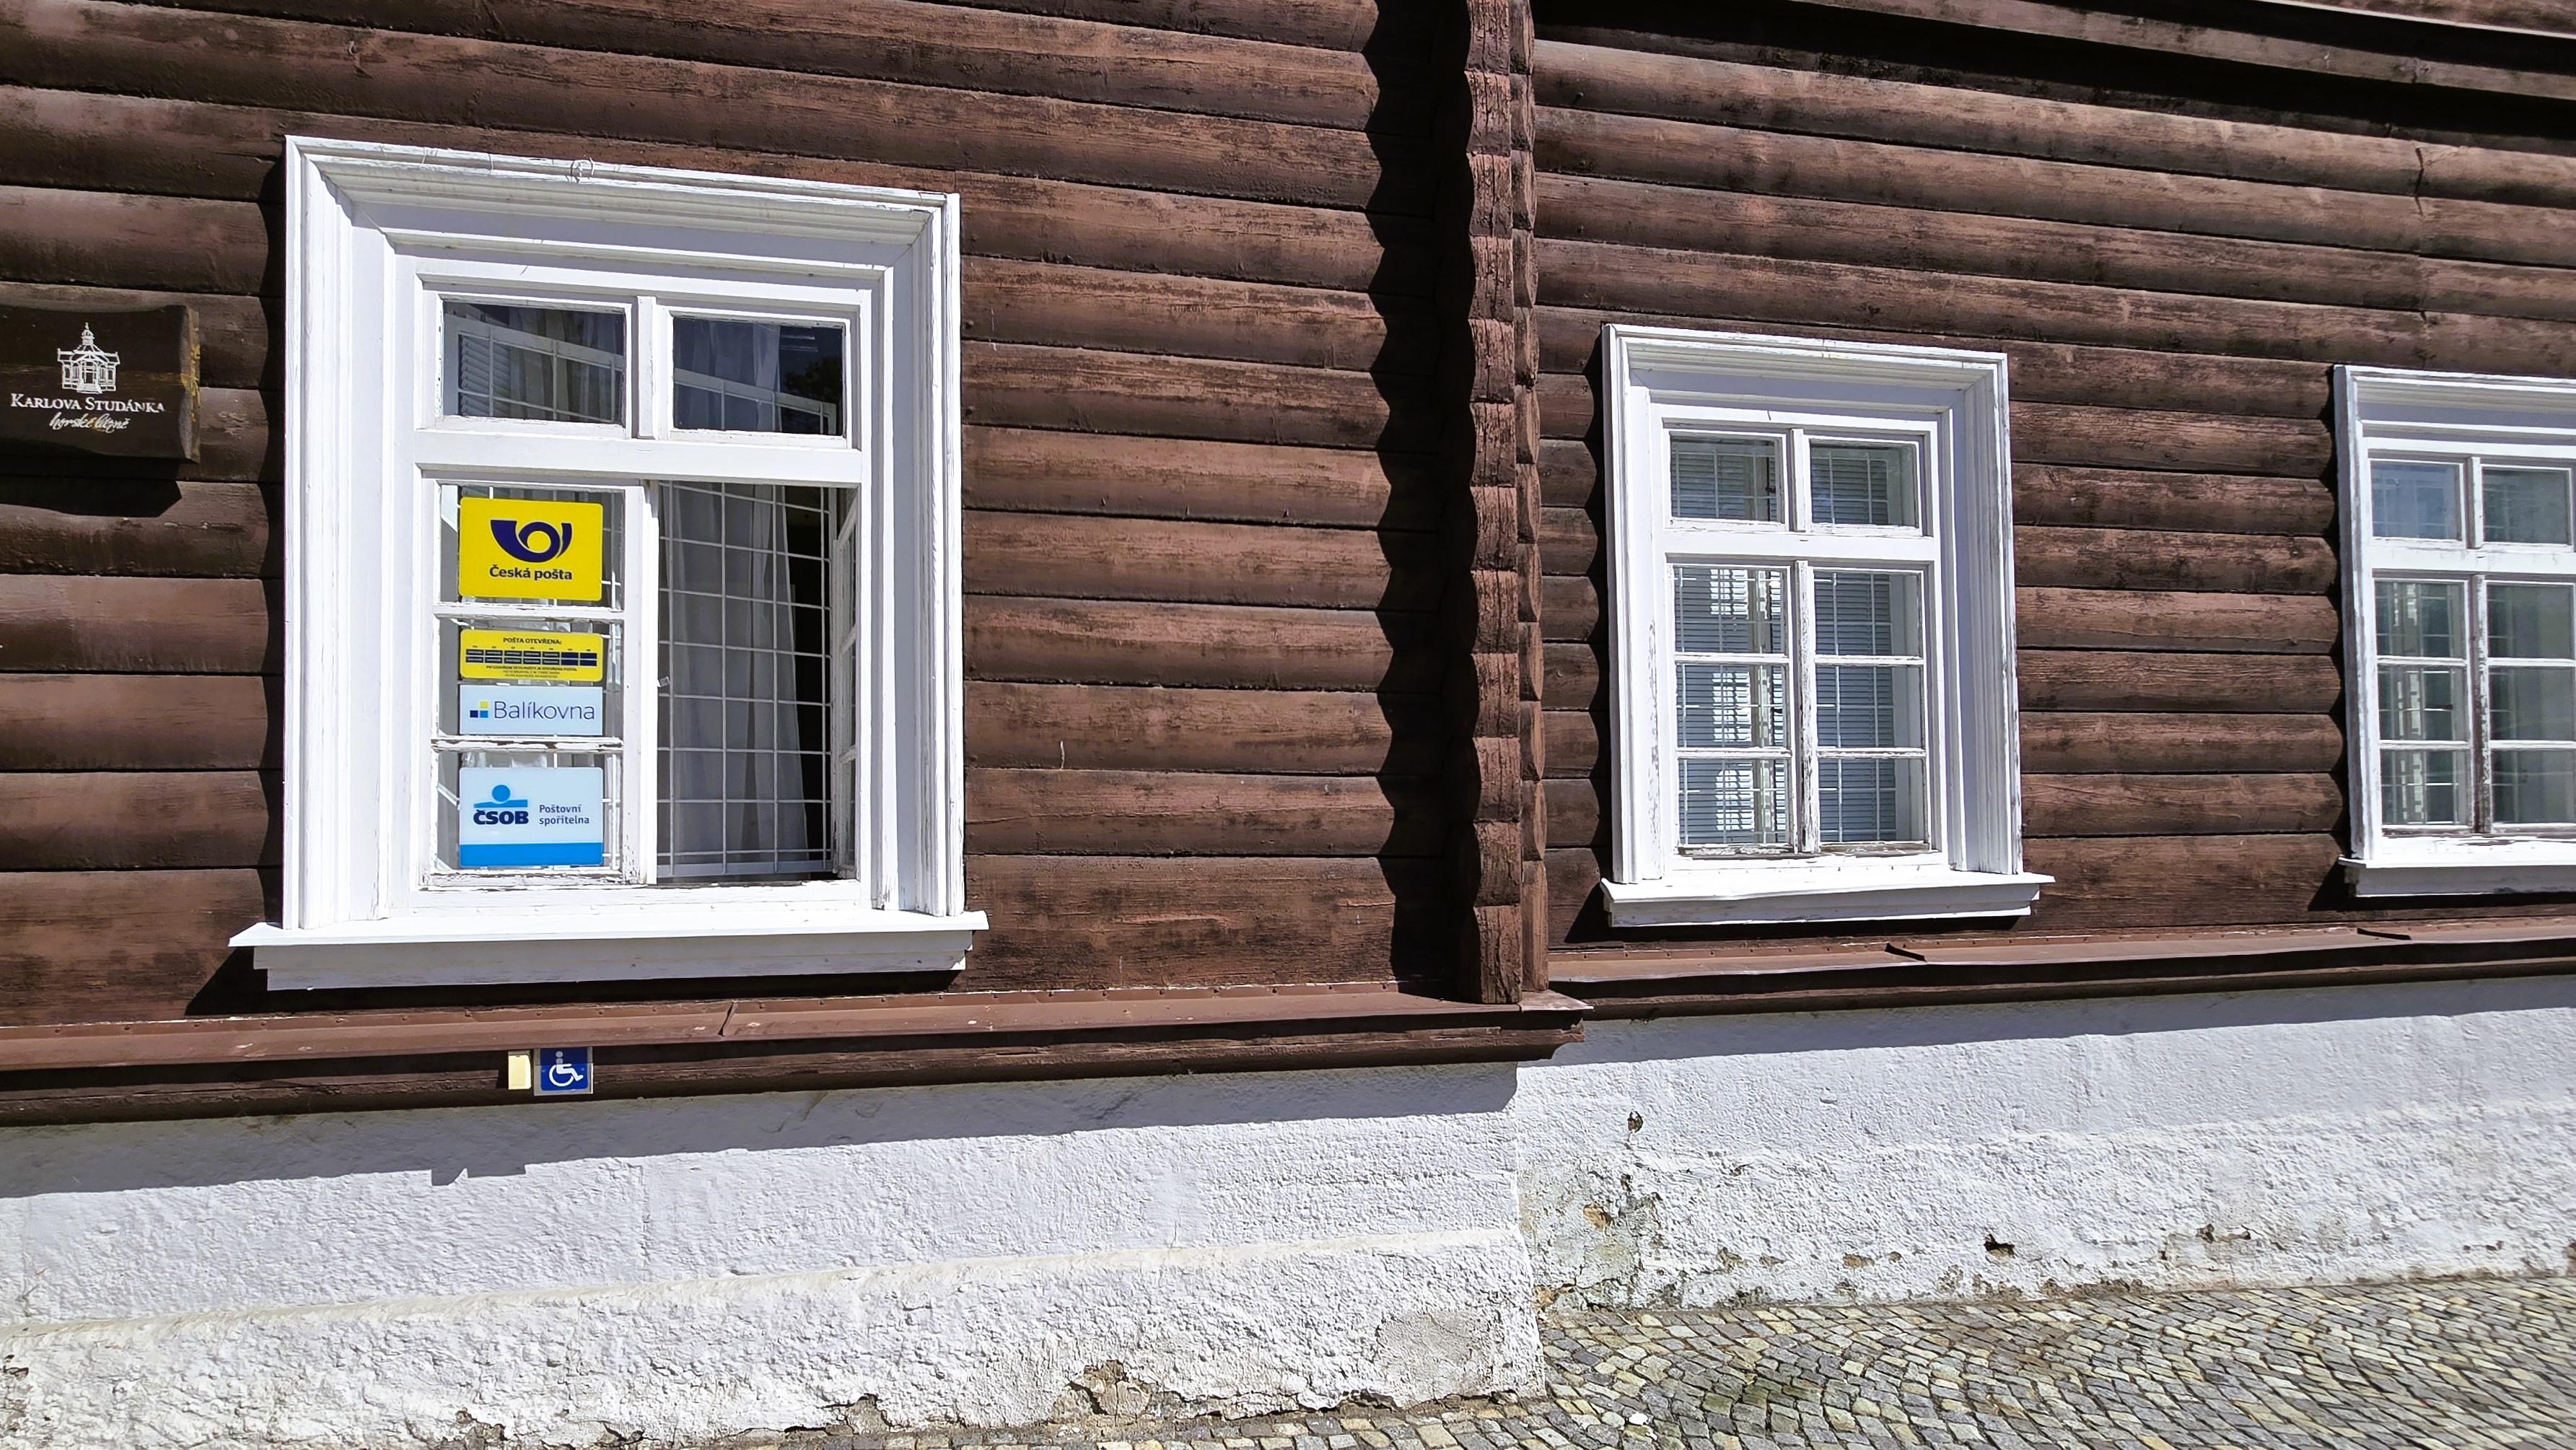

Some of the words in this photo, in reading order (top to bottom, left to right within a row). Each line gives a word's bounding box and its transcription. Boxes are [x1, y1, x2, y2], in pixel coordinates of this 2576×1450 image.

[11, 393, 82, 410] KARLOVA
[85, 397, 165, 413] STUDÁNKA
[489, 564, 531, 578] Česká
[534, 569, 572, 580] pošta
[494, 701, 595, 720] Balíkovna
[539, 804, 582, 813] Poštovní
[473, 809, 529, 825] ČSOB
[539, 816, 590, 826] spořitelna
